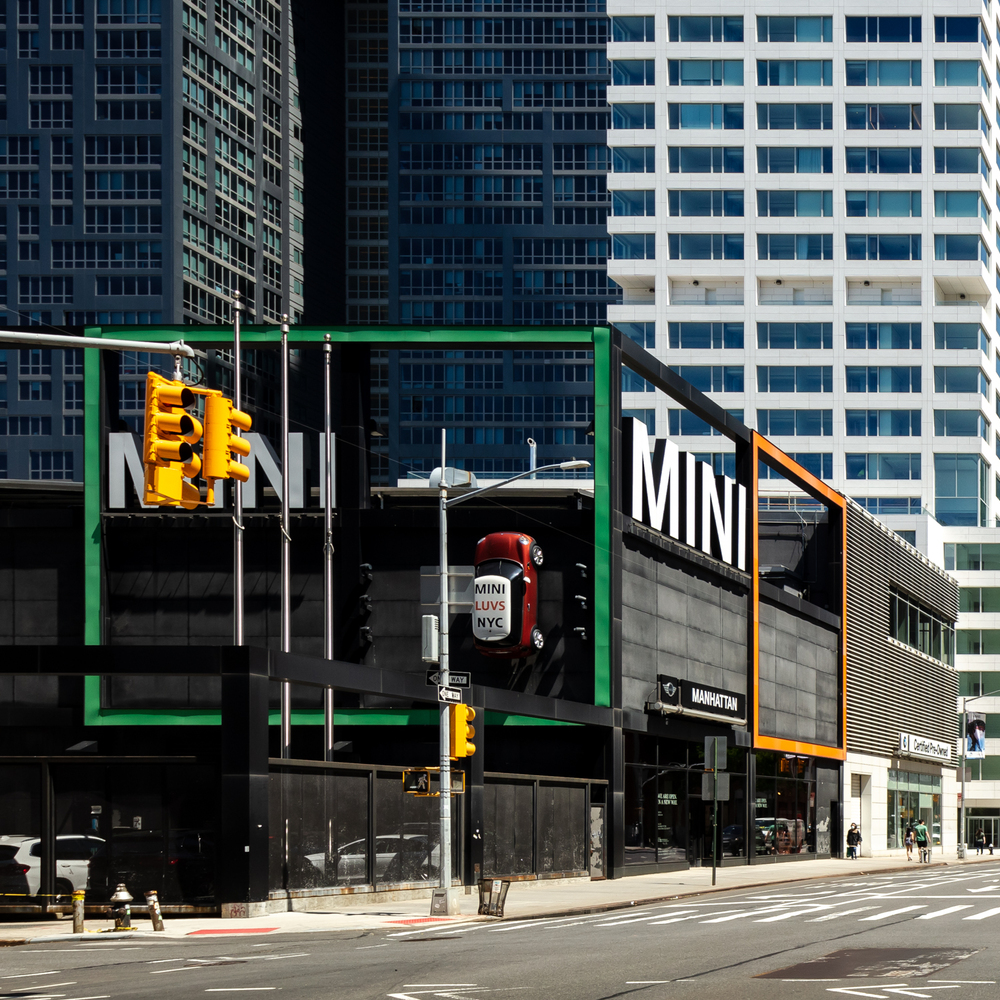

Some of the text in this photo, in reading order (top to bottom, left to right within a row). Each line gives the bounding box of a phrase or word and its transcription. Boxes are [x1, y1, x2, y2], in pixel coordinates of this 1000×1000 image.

[108, 432, 336, 509] MNI
[631, 416, 746, 572] MINI
[475, 584, 505, 594] MINI
[475, 601, 506, 611] LUVS
[477, 618, 503, 628] NYC
[692, 687, 738, 711] MANHATTAN
[914, 738, 948, 757] Certified Pre-Owned
